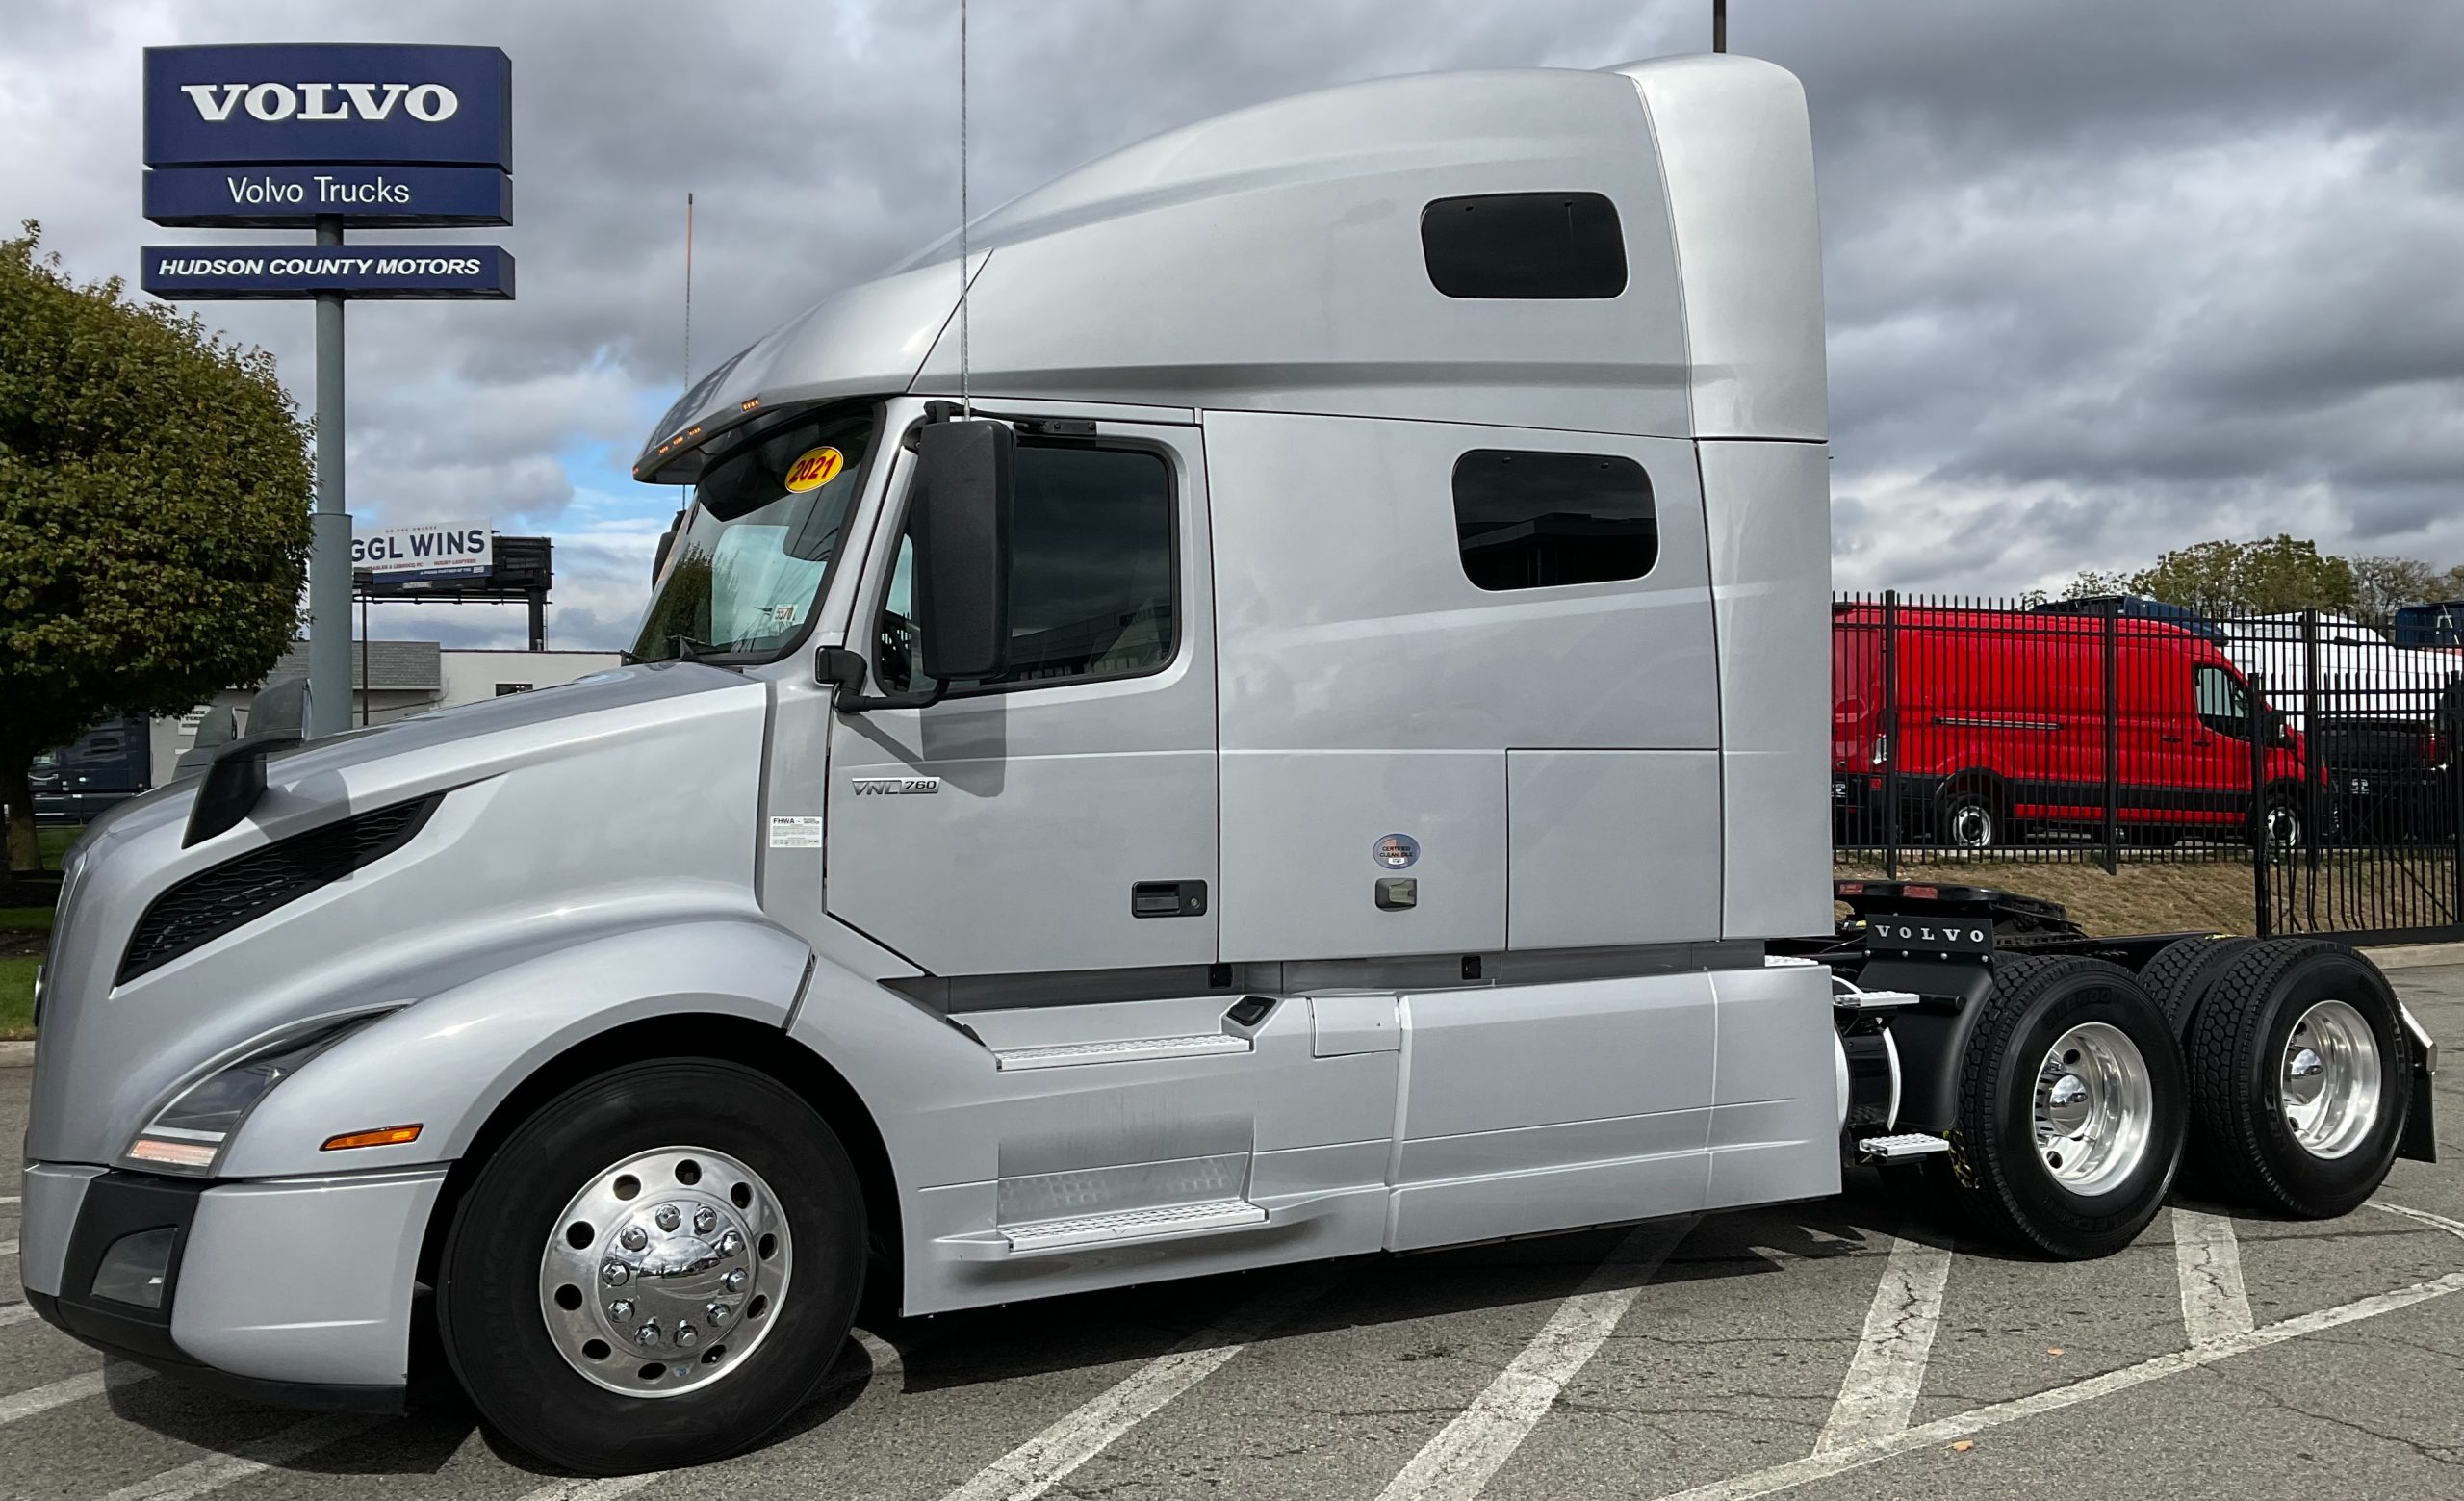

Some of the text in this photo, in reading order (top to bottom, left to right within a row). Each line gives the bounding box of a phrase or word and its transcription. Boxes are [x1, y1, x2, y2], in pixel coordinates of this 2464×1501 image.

[180, 82, 458, 122] VOLVO
[227, 175, 410, 204] Volvo Trucks
[158, 257, 481, 276] HUDSON COUNTY MOTORS
[787, 454, 837, 485] 2021
[410, 530, 485, 557] WINS
[904, 780, 937, 789] 760
[1875, 924, 1984, 943] VOLVO
